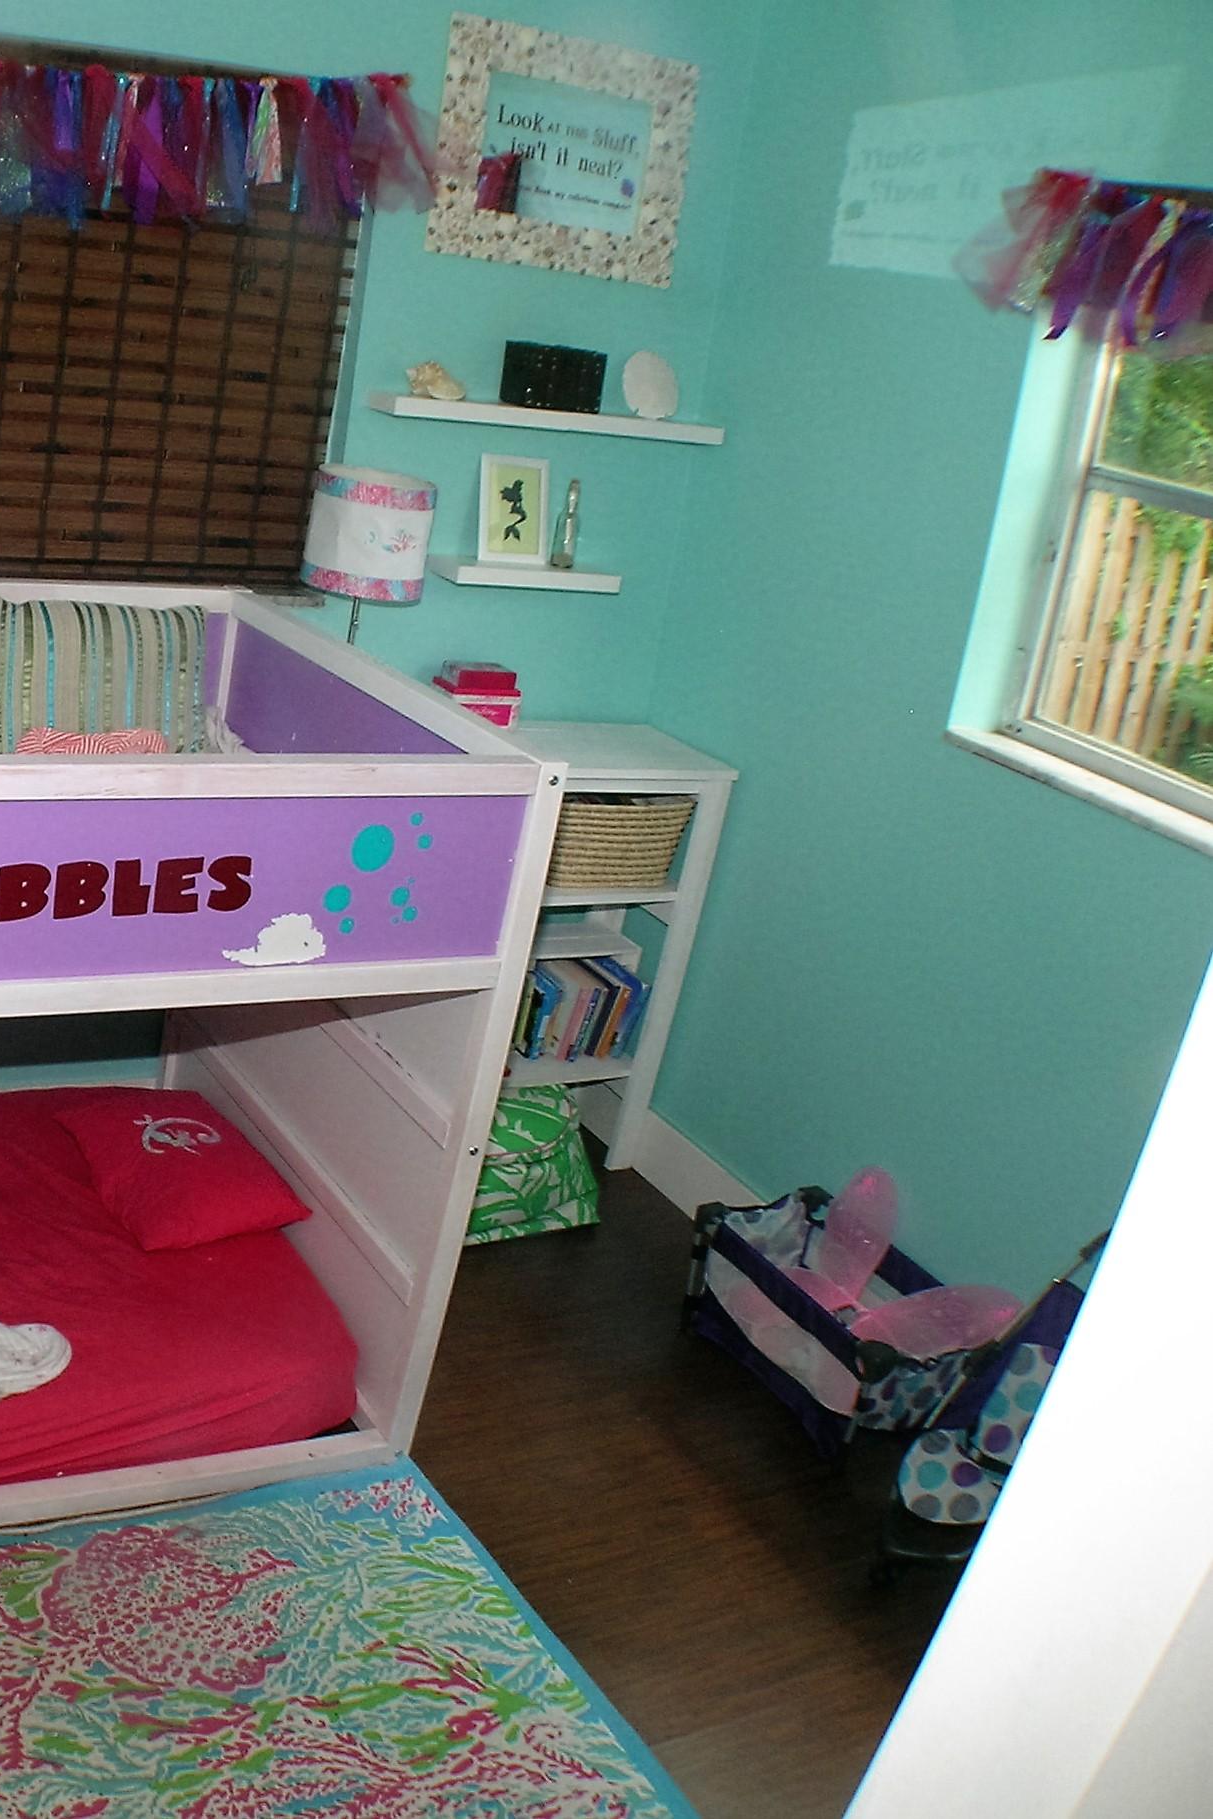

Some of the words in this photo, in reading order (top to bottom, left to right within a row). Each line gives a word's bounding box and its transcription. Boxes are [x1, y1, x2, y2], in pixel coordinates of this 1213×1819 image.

[497, 104, 544, 133] Look
[510, 137, 546, 160] isn't
[556, 147, 568, 166] it
[578, 157, 623, 179] neat?
